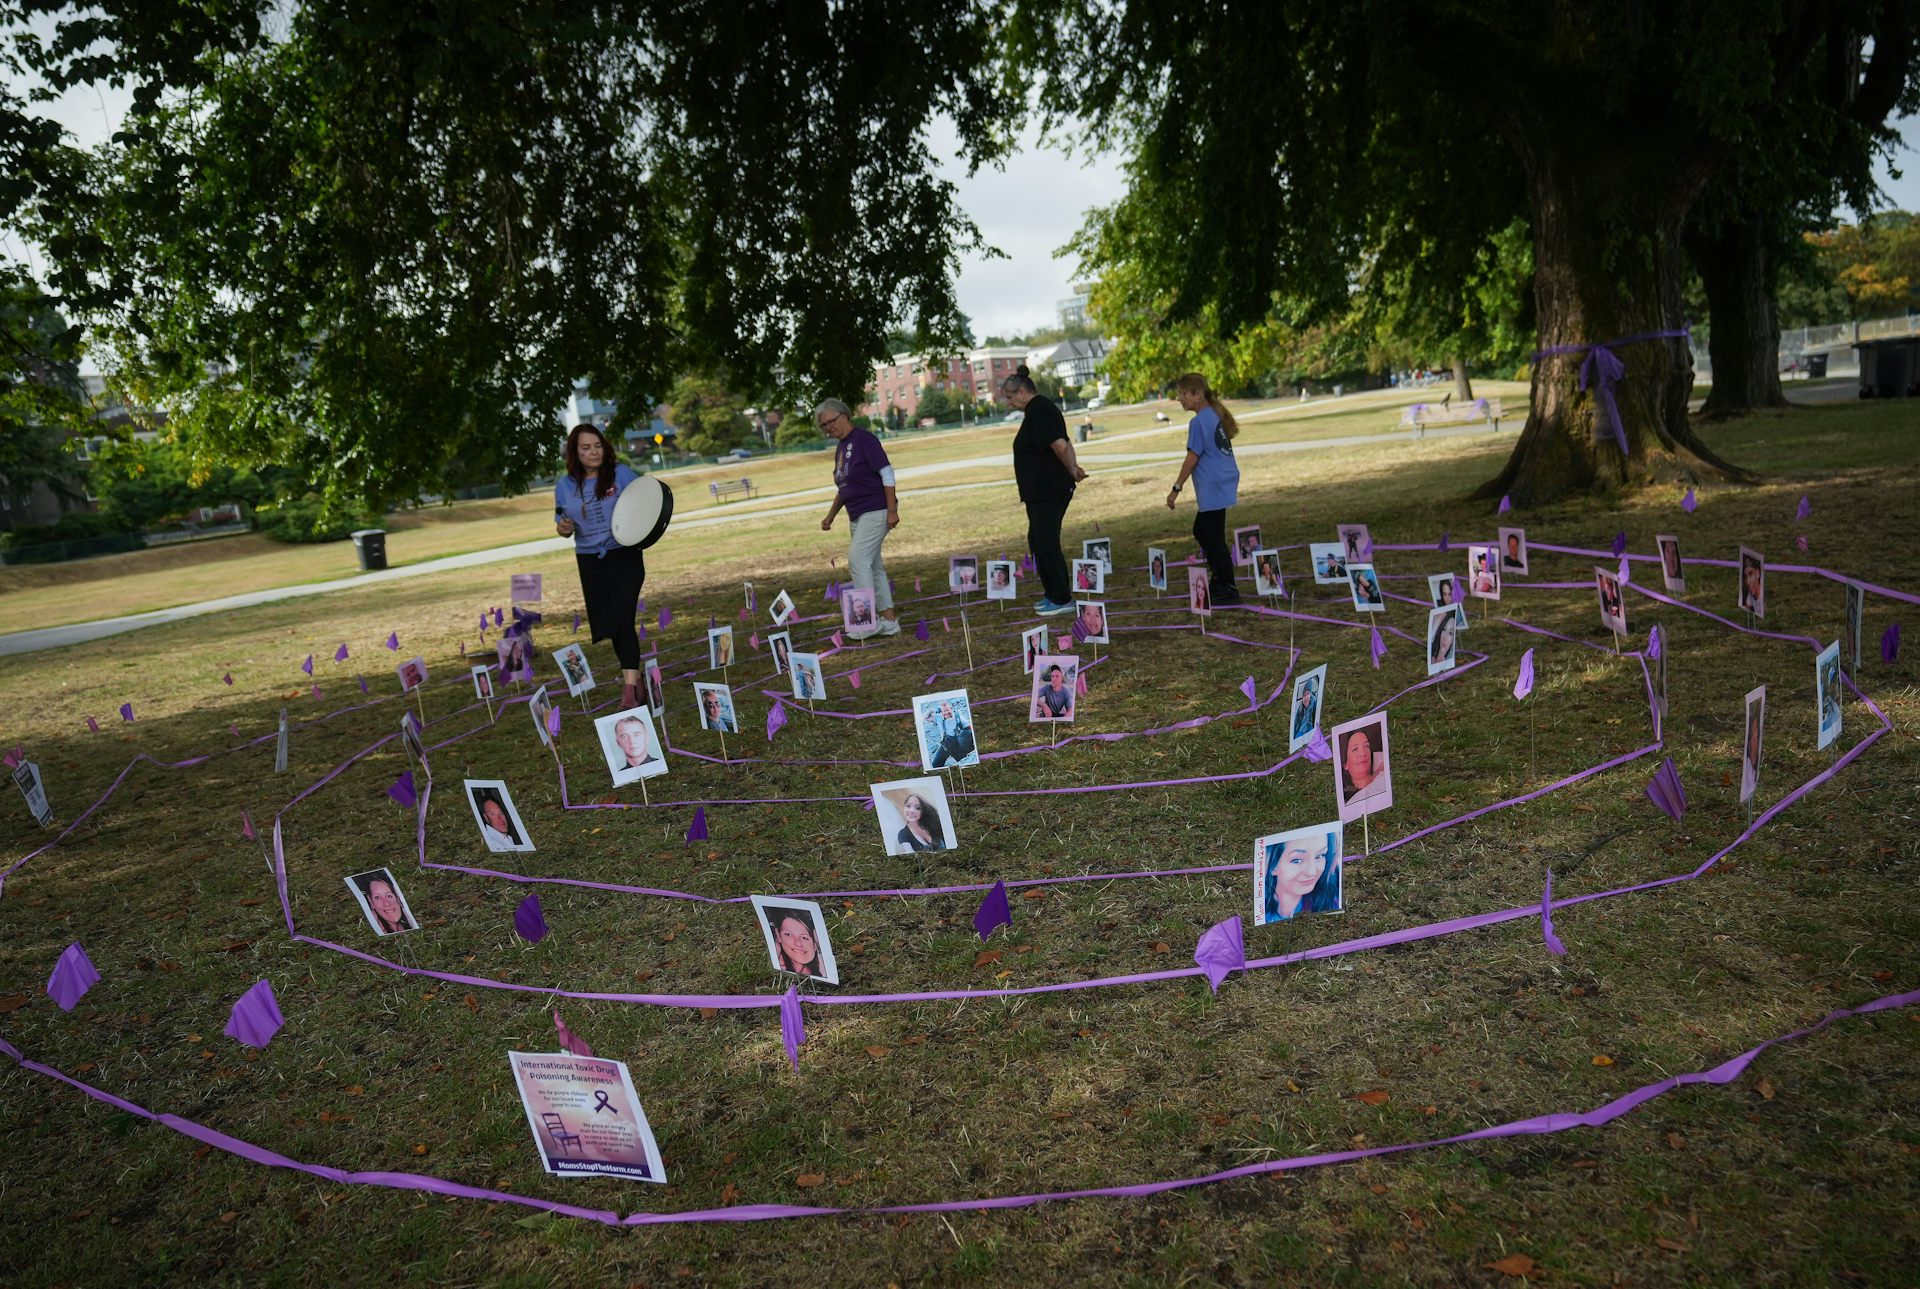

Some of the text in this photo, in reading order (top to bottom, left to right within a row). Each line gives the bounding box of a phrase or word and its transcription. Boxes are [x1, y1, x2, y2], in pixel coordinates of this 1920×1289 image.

[520, 1060, 616, 1077] International Toxic Drug
[529, 1072, 614, 1085] Poisoning Awareness
[558, 1162, 642, 1175] MomsStopTheHarm.com
